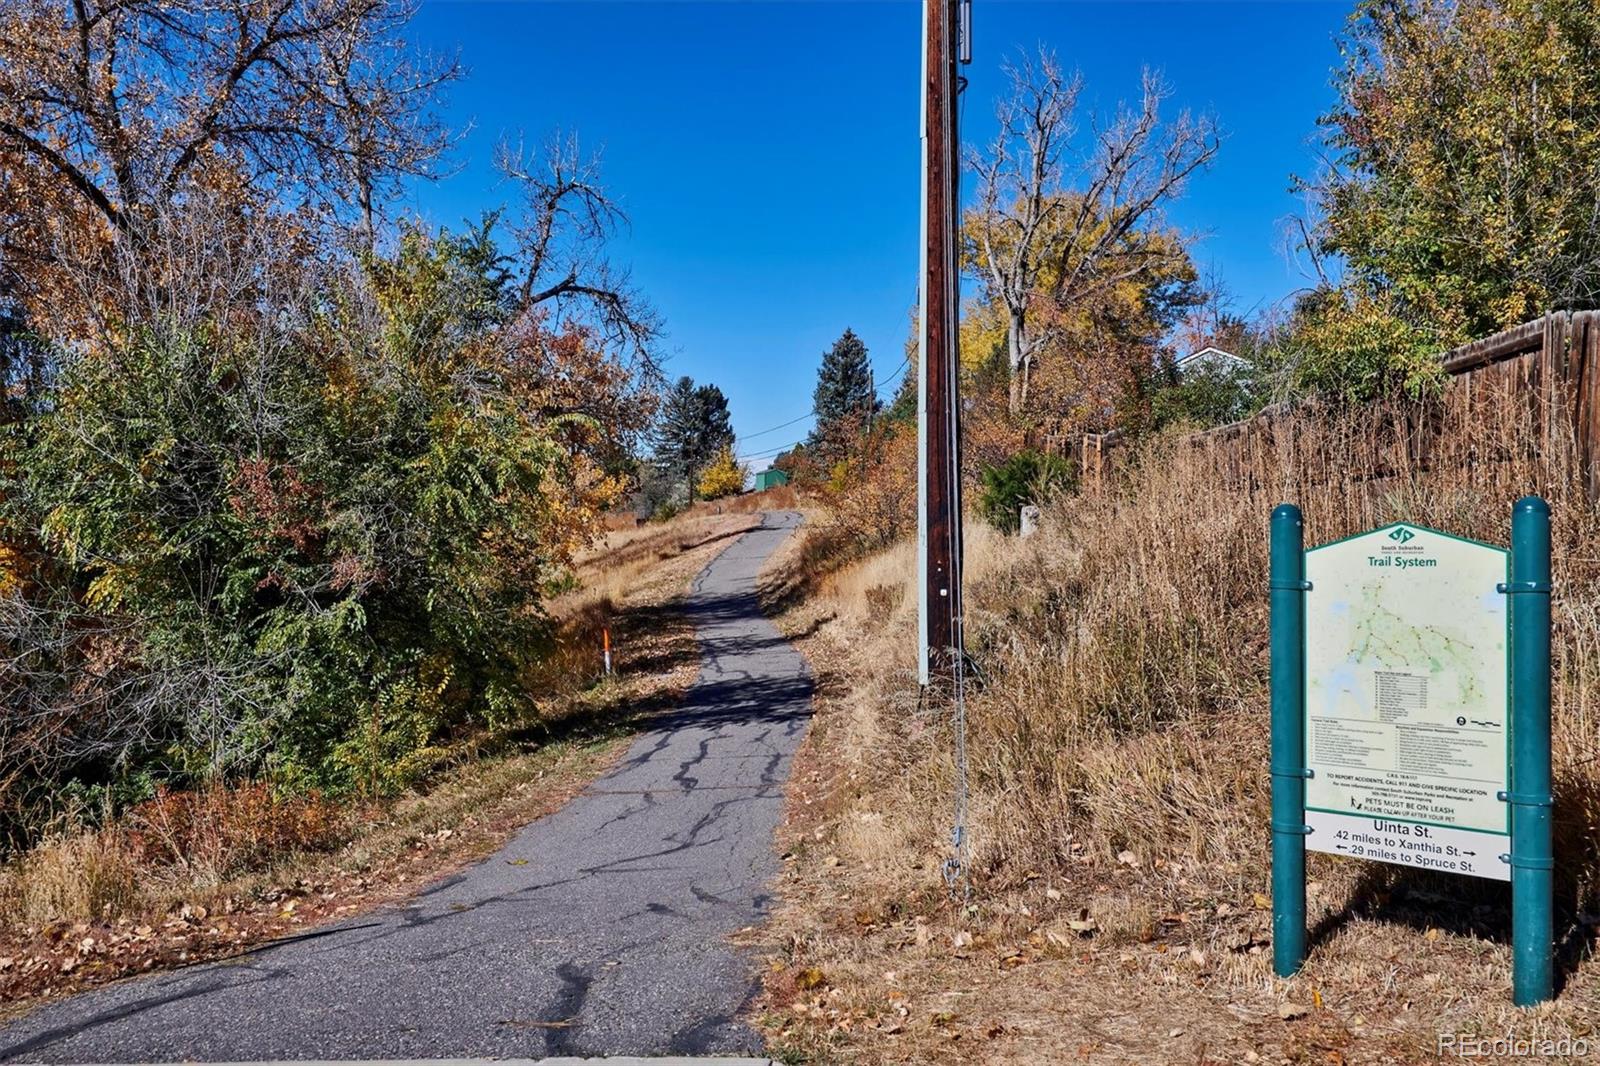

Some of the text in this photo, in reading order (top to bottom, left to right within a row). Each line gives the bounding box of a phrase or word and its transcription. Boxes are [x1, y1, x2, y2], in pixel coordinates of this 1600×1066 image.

[1368, 556, 1437, 569] Trail System
[1374, 820, 1433, 838] Uinta St.
[1333, 830, 1461, 857] .42 miles to Xanthia St.
[1348, 845, 1475, 872] .29 miles to Spruce St.
